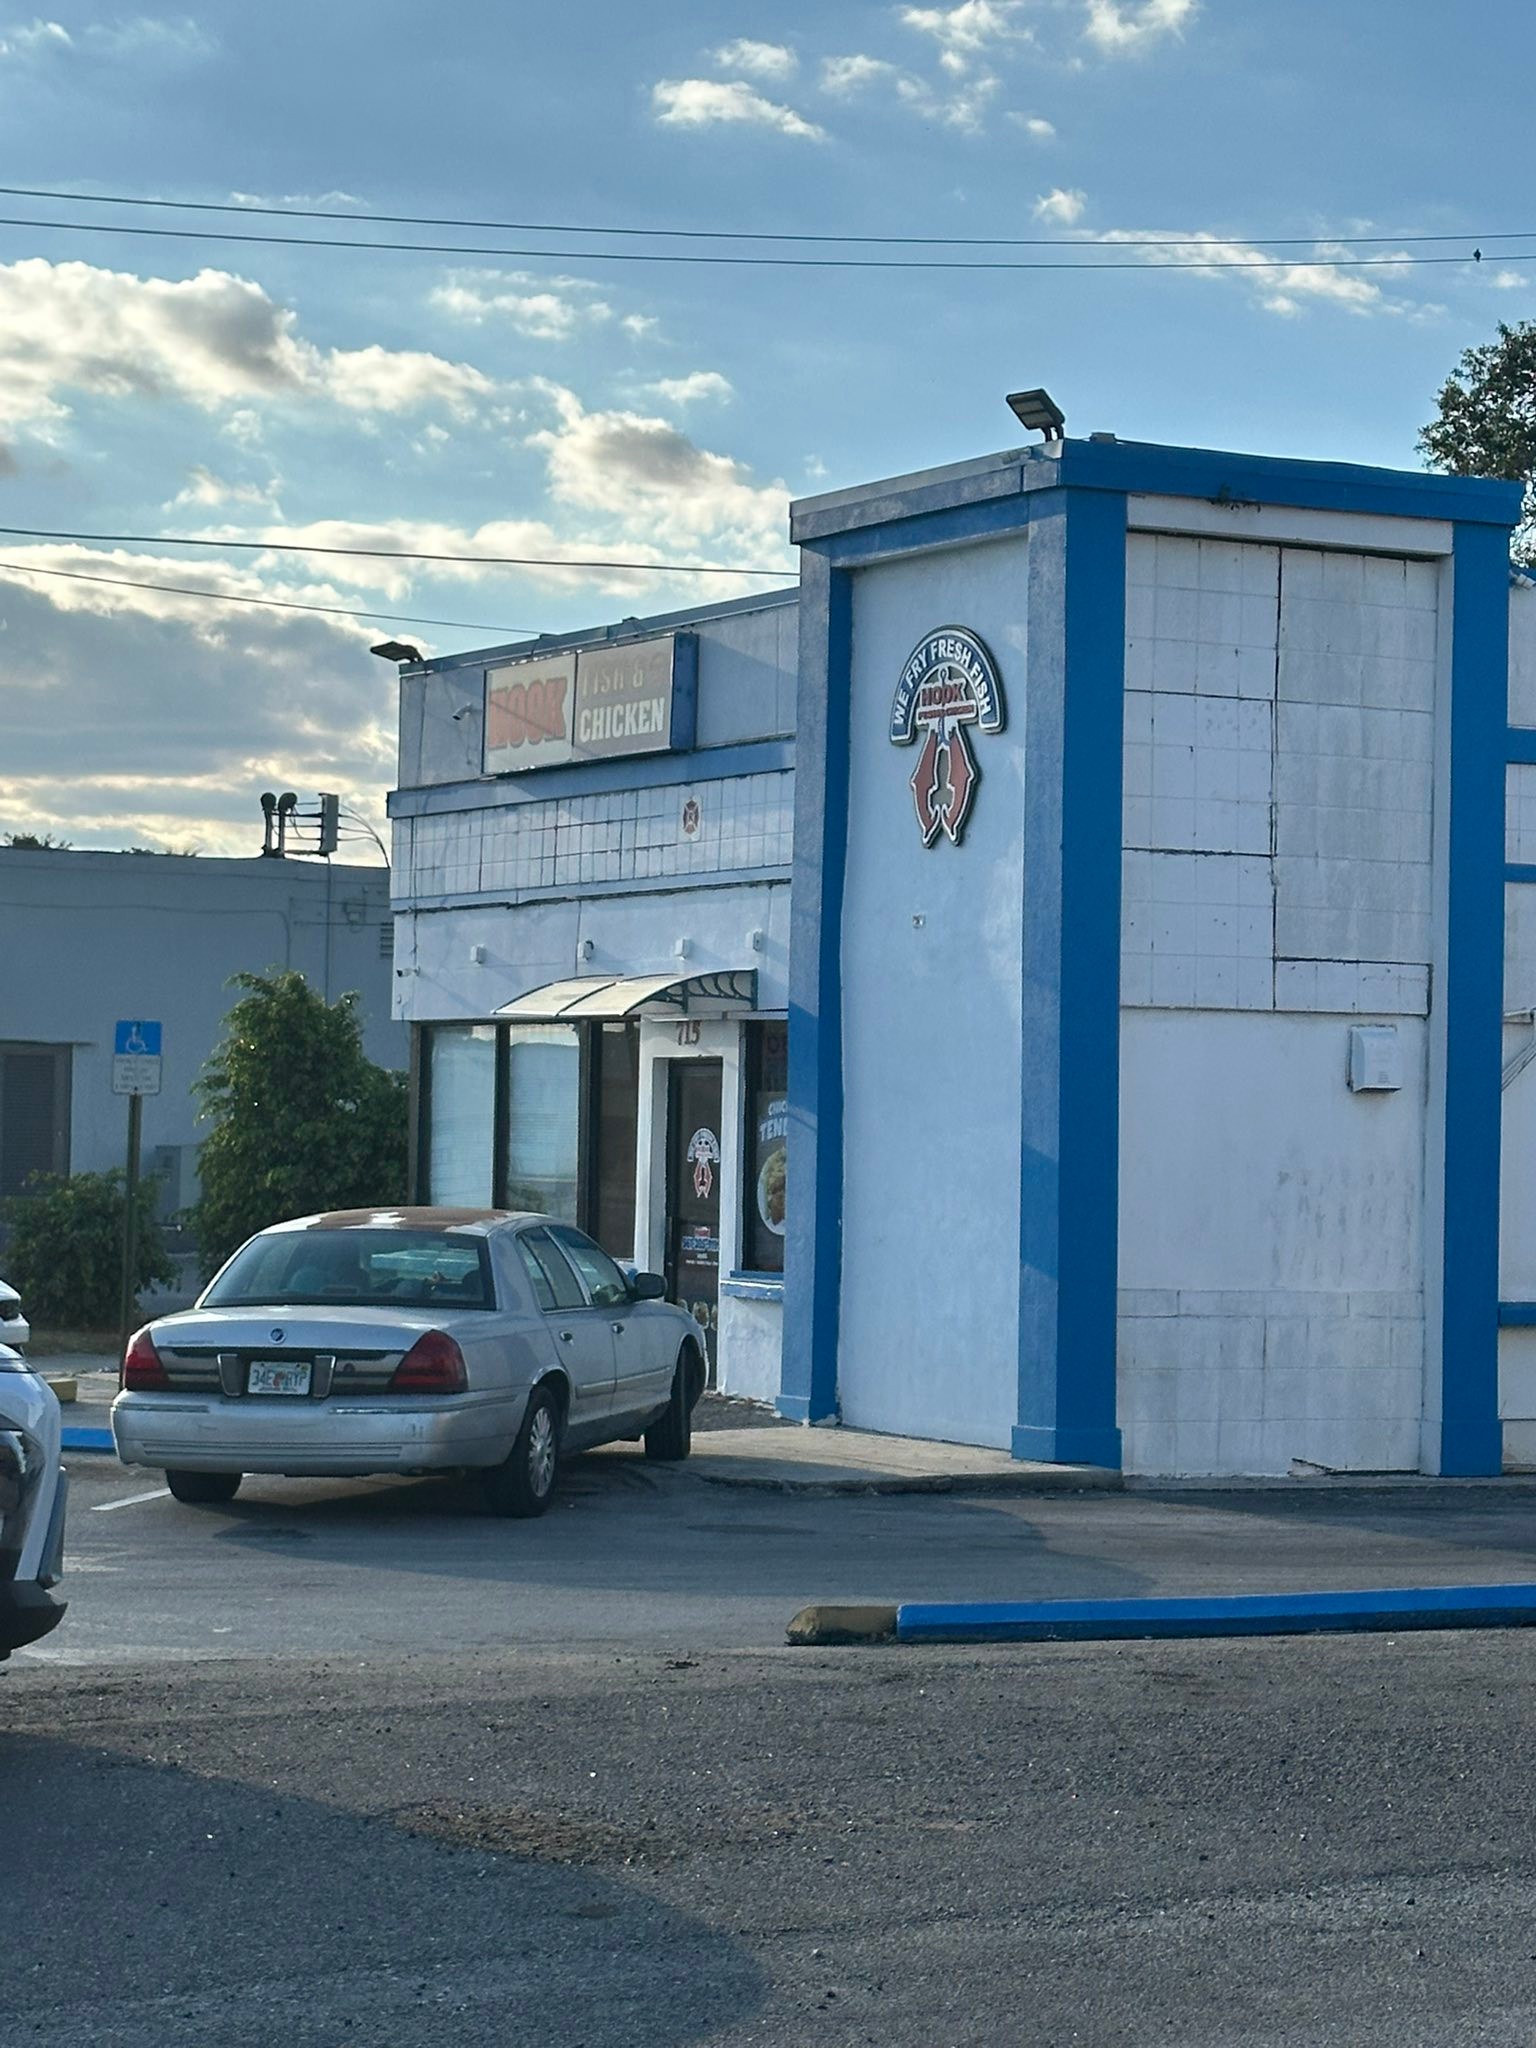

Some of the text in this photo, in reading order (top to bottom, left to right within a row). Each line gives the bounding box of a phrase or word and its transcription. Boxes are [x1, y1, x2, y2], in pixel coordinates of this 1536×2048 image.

[894, 690, 909, 724] WE
[906, 650, 927, 688] FRY
[931, 639, 971, 666] FRESH
[970, 663, 991, 715] FISH
[921, 684, 963, 705] HOOK
[580, 698, 665, 742] CHICKEN
[675, 1021, 701, 1046] 715
